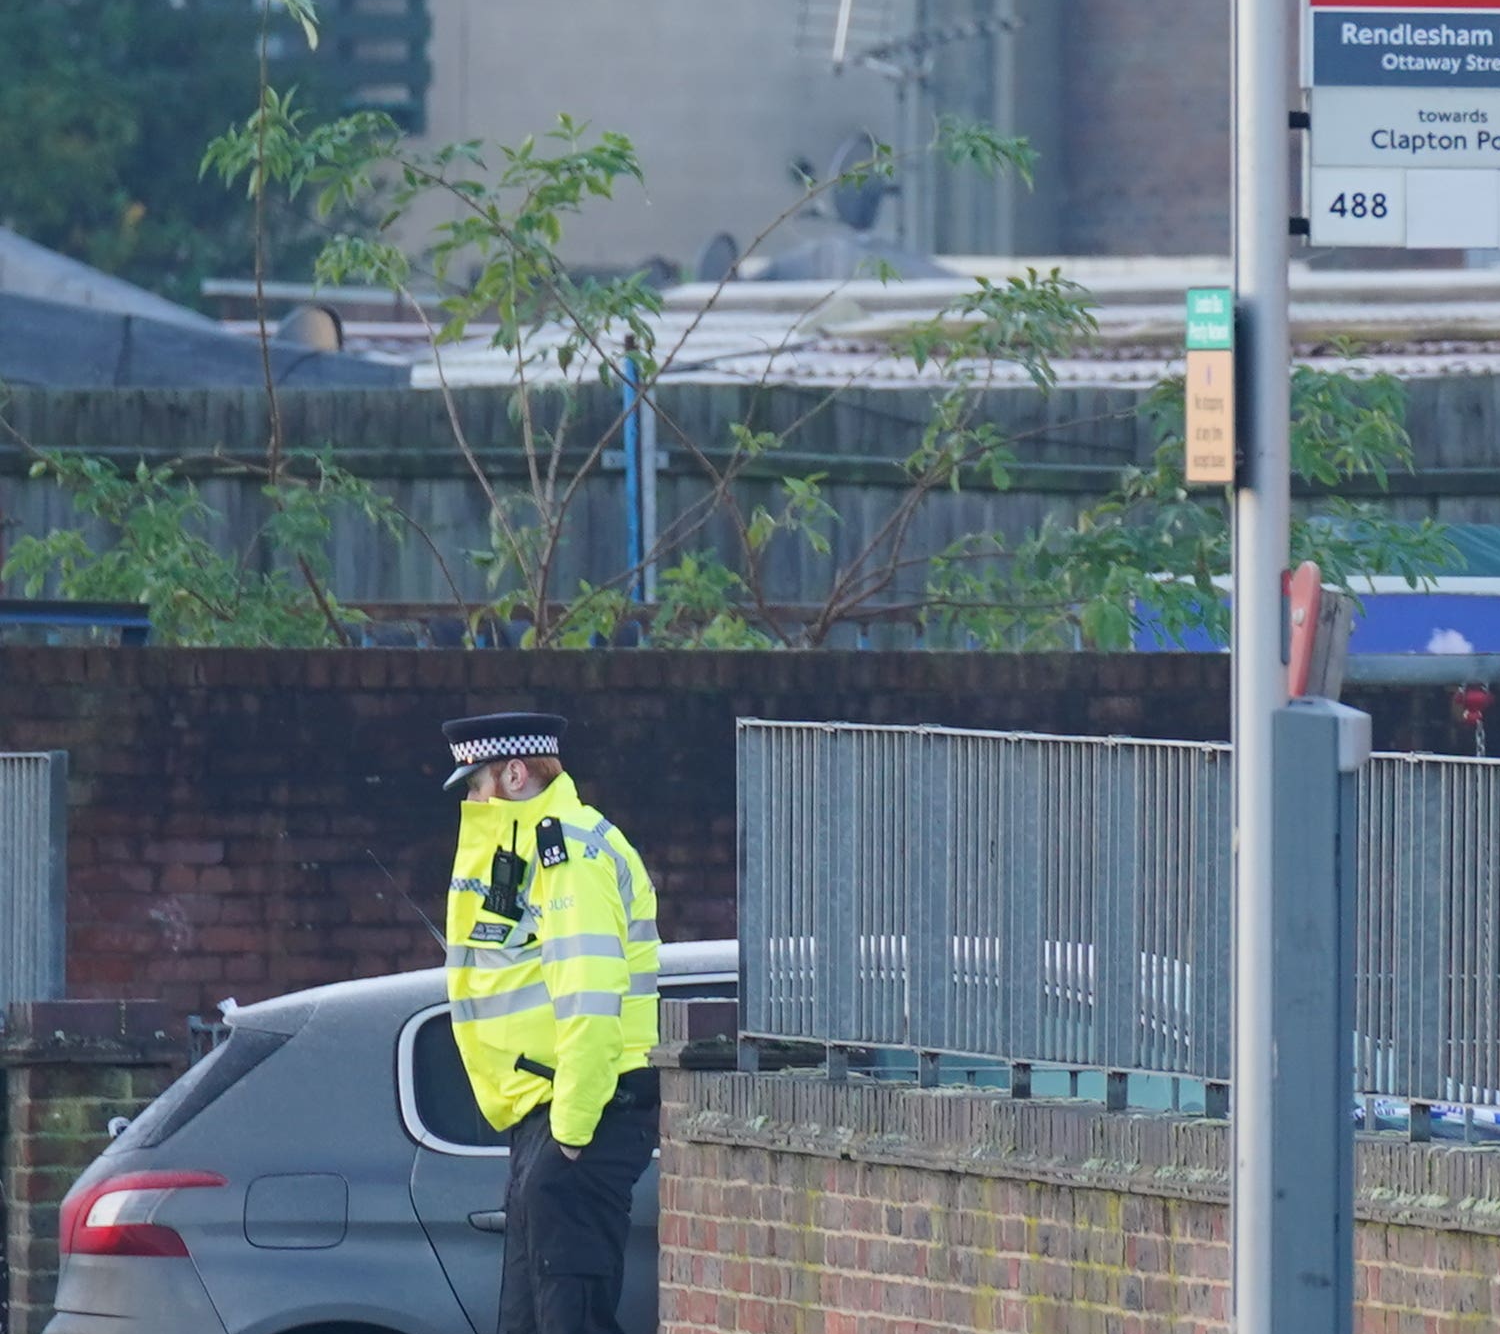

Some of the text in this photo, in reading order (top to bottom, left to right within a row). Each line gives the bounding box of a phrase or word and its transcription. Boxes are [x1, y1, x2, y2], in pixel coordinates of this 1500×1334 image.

[1341, 22, 1493, 46] Rendlesham
[1381, 52, 1461, 74] Ottaway
[1418, 109, 1488, 123] towards
[1371, 129, 1467, 154] Clapton
[1329, 192, 1387, 218] 488
[547, 894, 575, 911] OLICE
